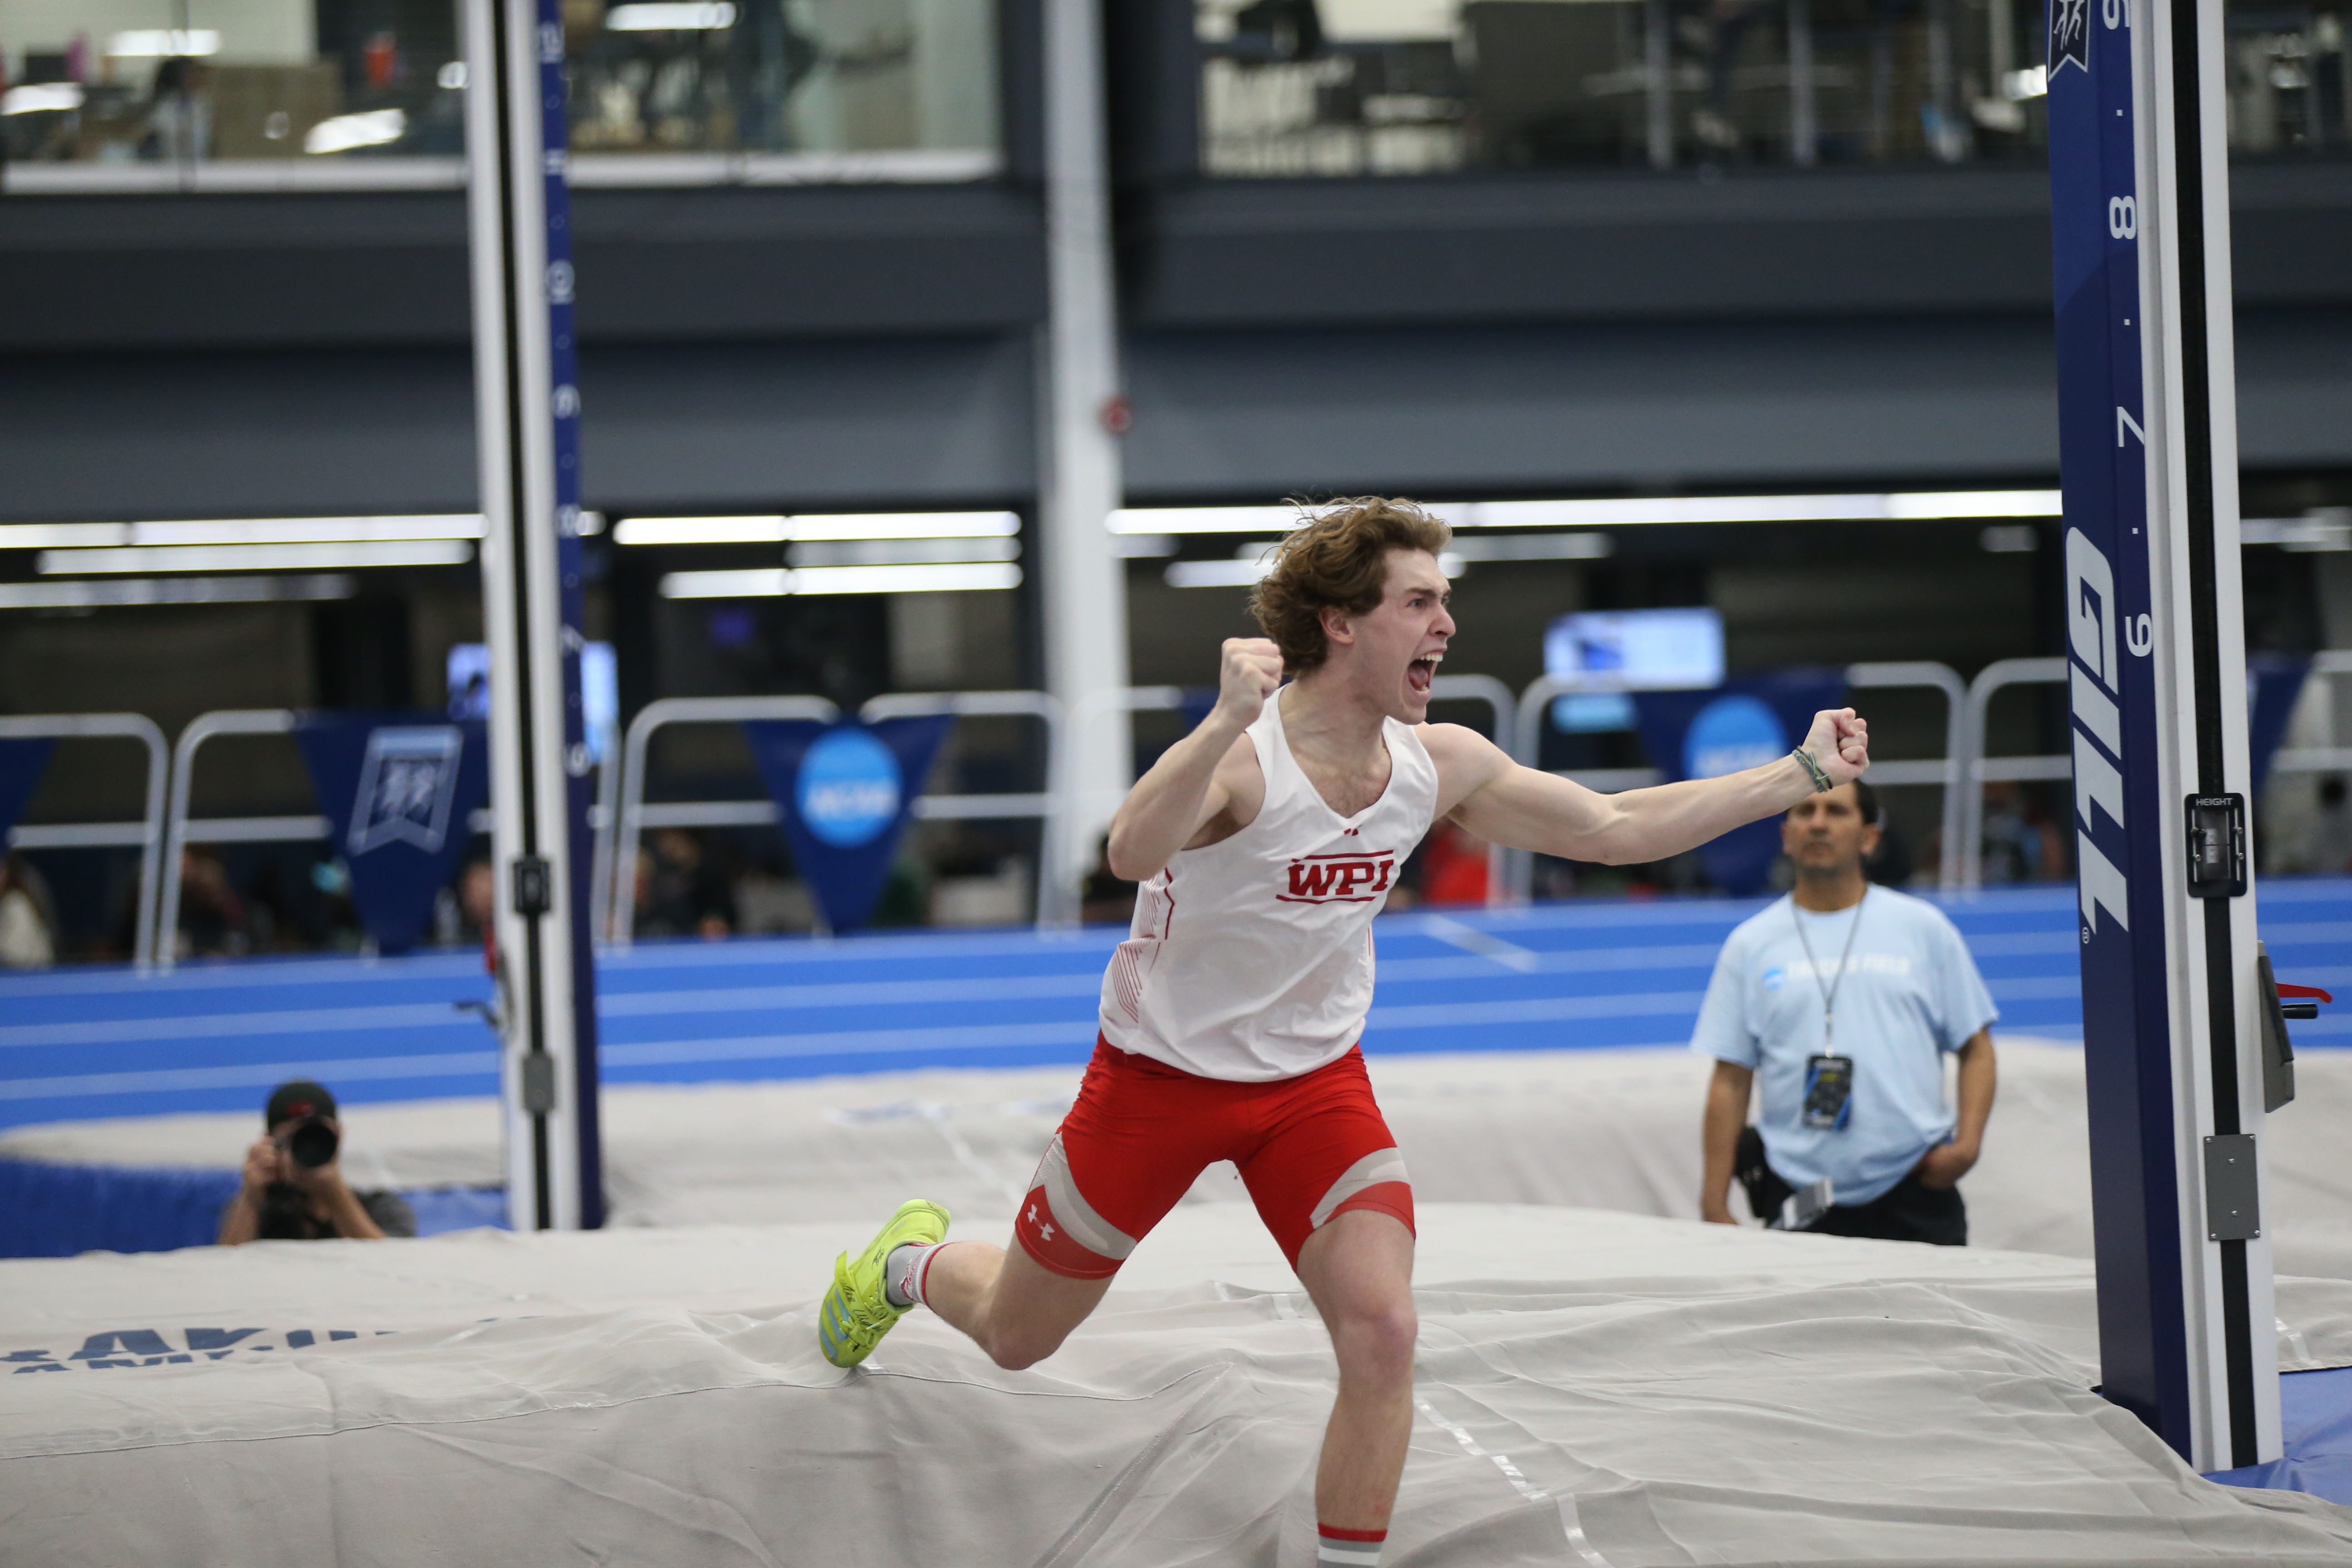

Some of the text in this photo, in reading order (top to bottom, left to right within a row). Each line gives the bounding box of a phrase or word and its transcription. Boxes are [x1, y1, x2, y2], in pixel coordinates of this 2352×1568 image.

[2109, 195, 2137, 240] 8
[2117, 406, 2145, 447] 7
[2125, 612, 2153, 657] 6
[2065, 526, 2129, 936] GILL
[2195, 798, 2233, 806] HEIGHT
[1288, 859, 1394, 896] WPI
